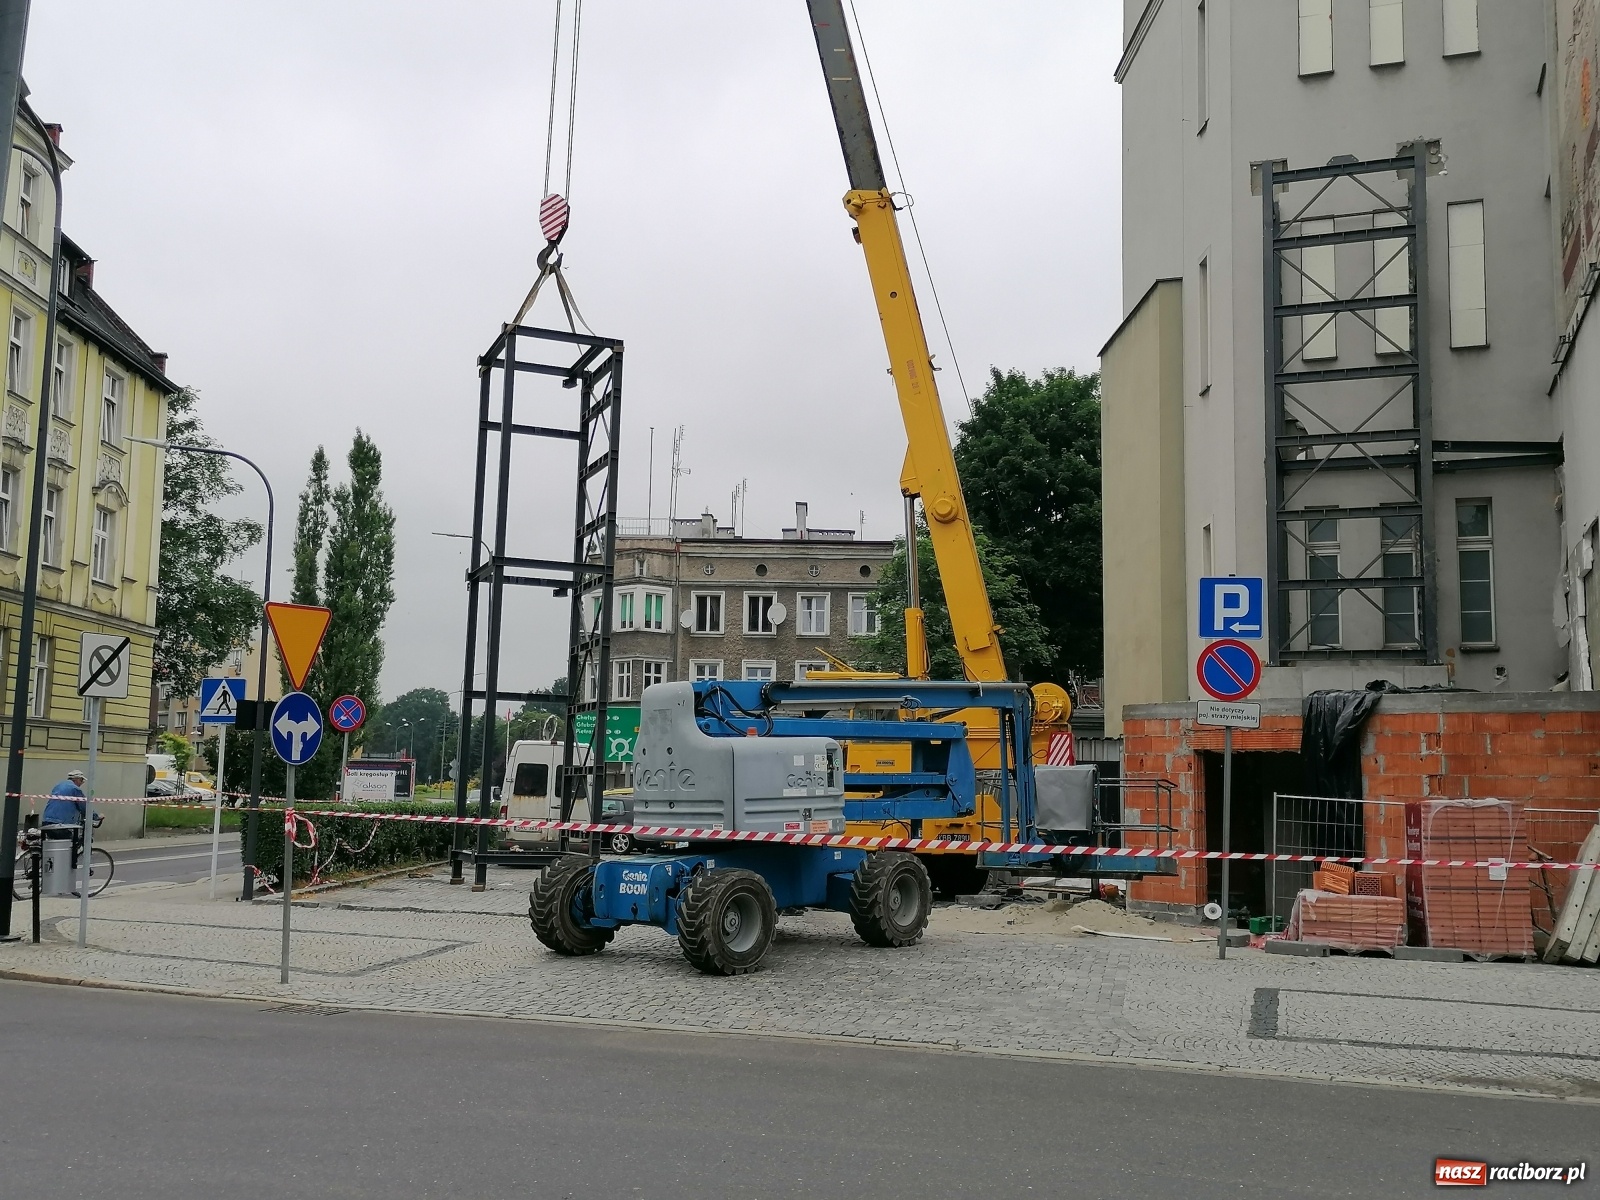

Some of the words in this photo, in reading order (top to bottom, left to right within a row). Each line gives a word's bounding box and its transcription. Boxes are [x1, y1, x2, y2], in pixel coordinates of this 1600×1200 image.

[1214, 584, 1250, 631] P
[576, 714, 597, 722] Chałup
[1230, 715, 1258, 723] miejskiej
[634, 761, 696, 792] Genie
[786, 773, 825, 790] Genie
[622, 870, 648, 882] Genie
